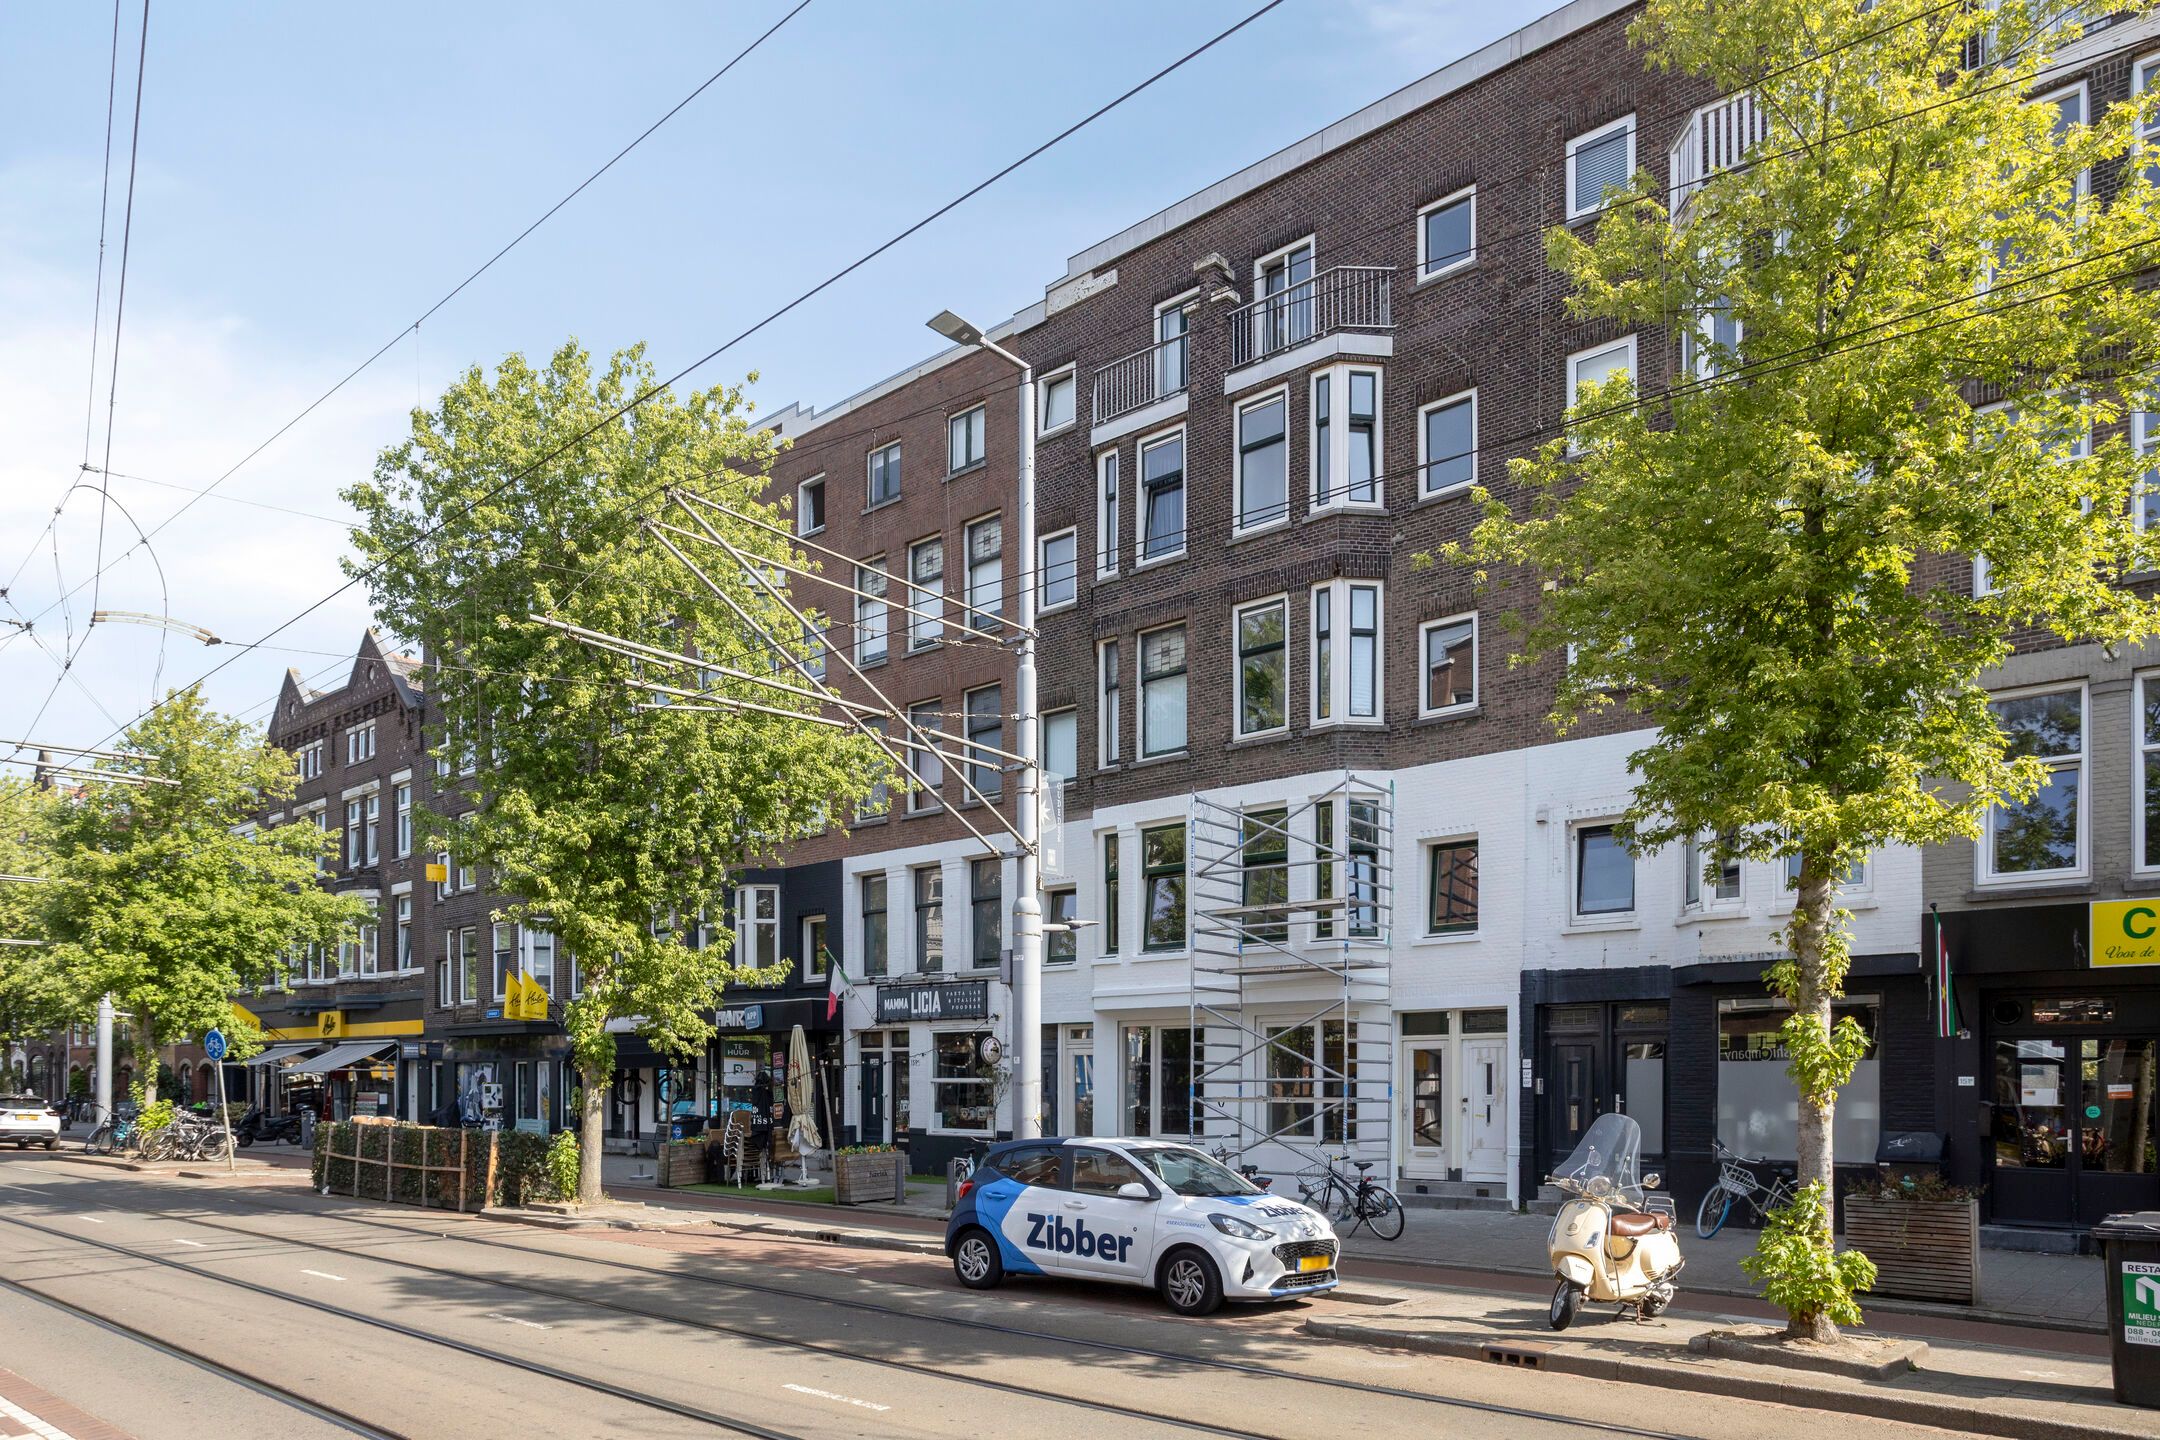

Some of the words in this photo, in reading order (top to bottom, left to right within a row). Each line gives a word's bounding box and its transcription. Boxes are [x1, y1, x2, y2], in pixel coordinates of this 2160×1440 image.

[2123, 907, 2157, 939] C
[2105, 945, 2136, 959] Voor
[2140, 946, 2155, 958] de
[884, 997, 909, 1011] MAMMA
[911, 990, 941, 1014] LICIA
[746, 1010, 758, 1021] APP
[734, 1043, 743, 1051] TE
[1026, 1213, 1133, 1263] Zibber
[2128, 1312, 2156, 1321] MILIEU
[2127, 1327, 2144, 1336] 088
